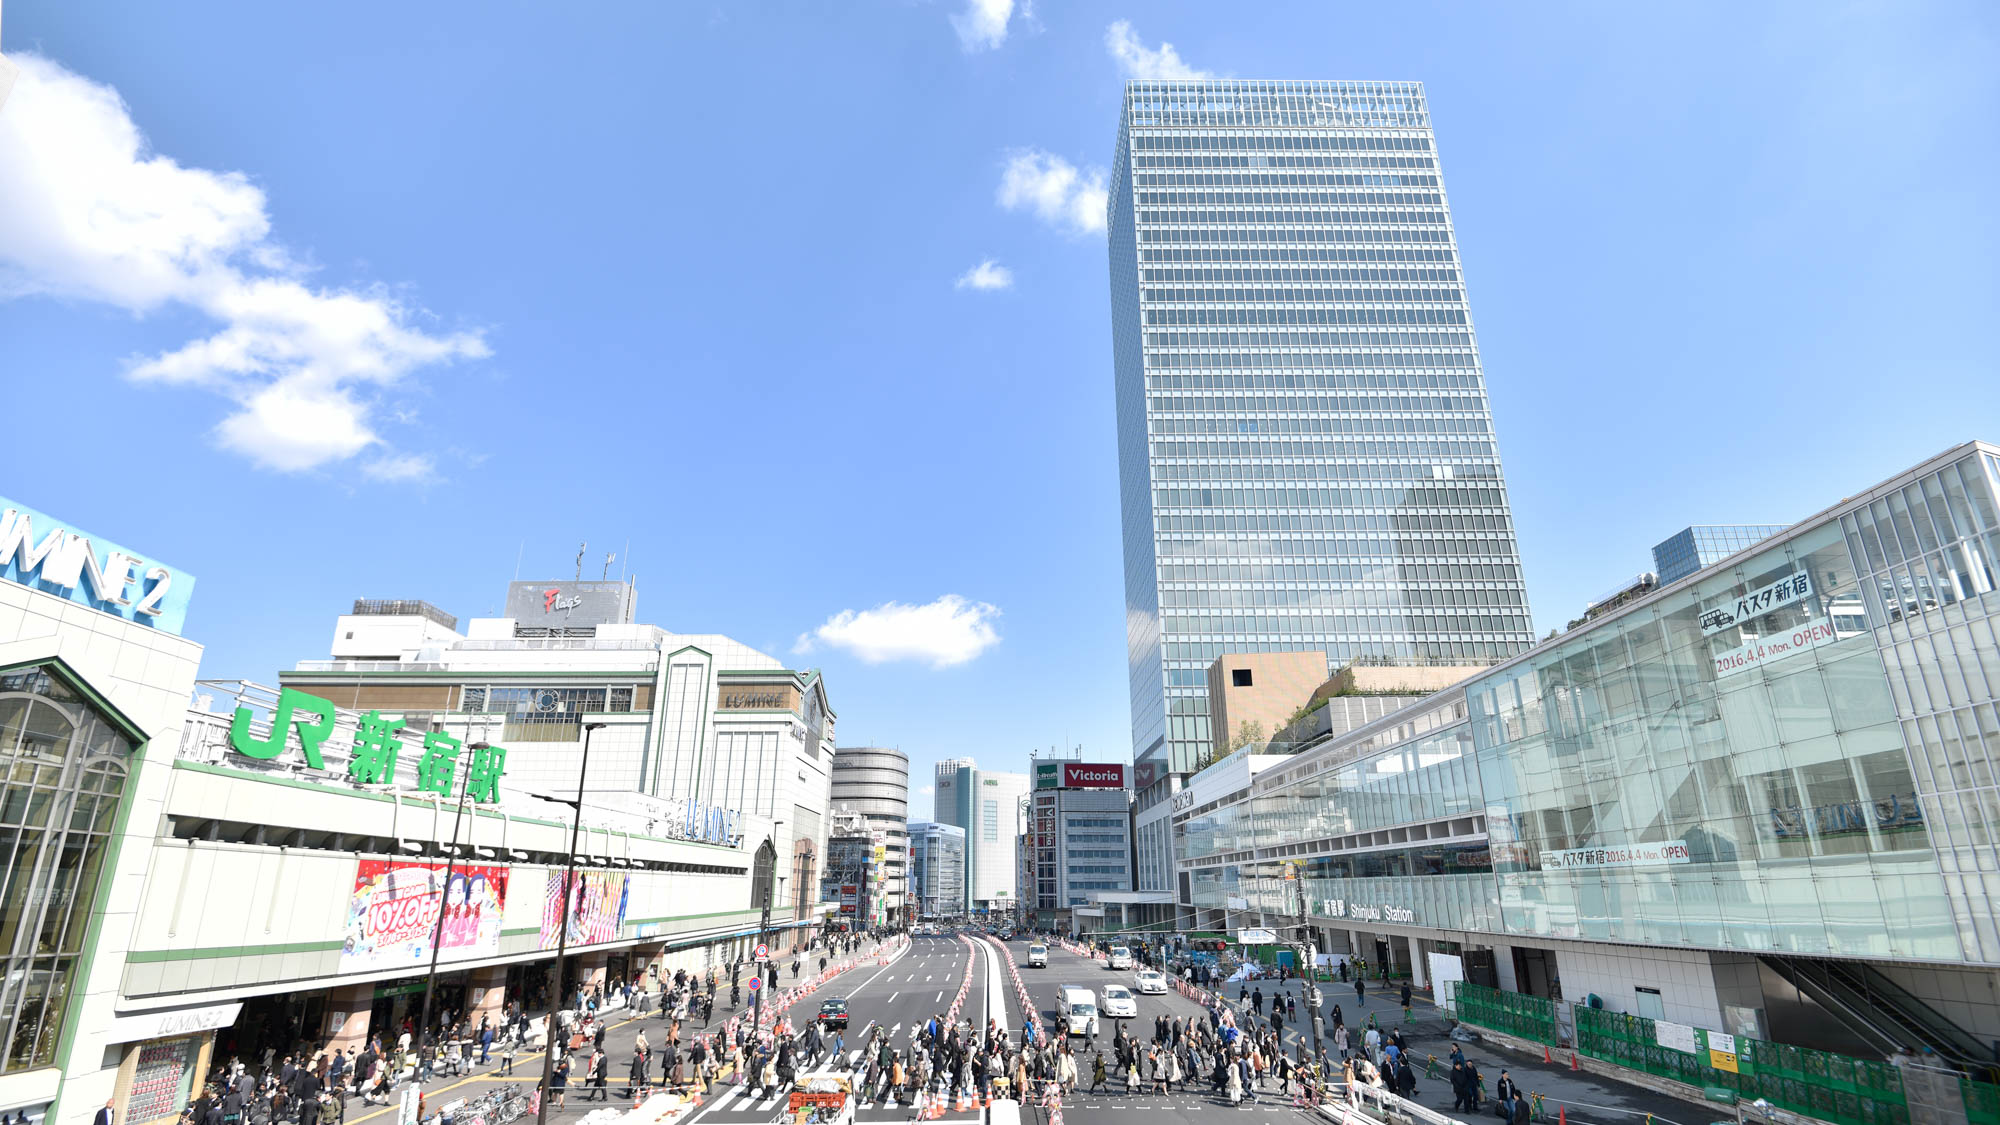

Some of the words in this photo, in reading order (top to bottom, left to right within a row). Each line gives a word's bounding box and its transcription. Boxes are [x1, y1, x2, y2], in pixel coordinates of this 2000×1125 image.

[544, 588, 582, 619] Flags
[1736, 574, 1808, 619] バスタ新宿
[1716, 645, 1766, 673] 2016.4.4
[1768, 644, 1792, 656] Mon.
[1792, 622, 1832, 648] OPEN
[725, 691, 785, 708] LUMINE
[1069, 769, 1119, 781] Victoria
[1562, 850, 1605, 866] バスタ新宿
[1606, 849, 1642, 863] 2016.4.4
[1661, 845, 1689, 859] OPEN
[1323, 899, 1345, 917] 新宿駅
[1351, 903, 1380, 923] Shinjuku
[1385, 904, 1413, 923] Station
